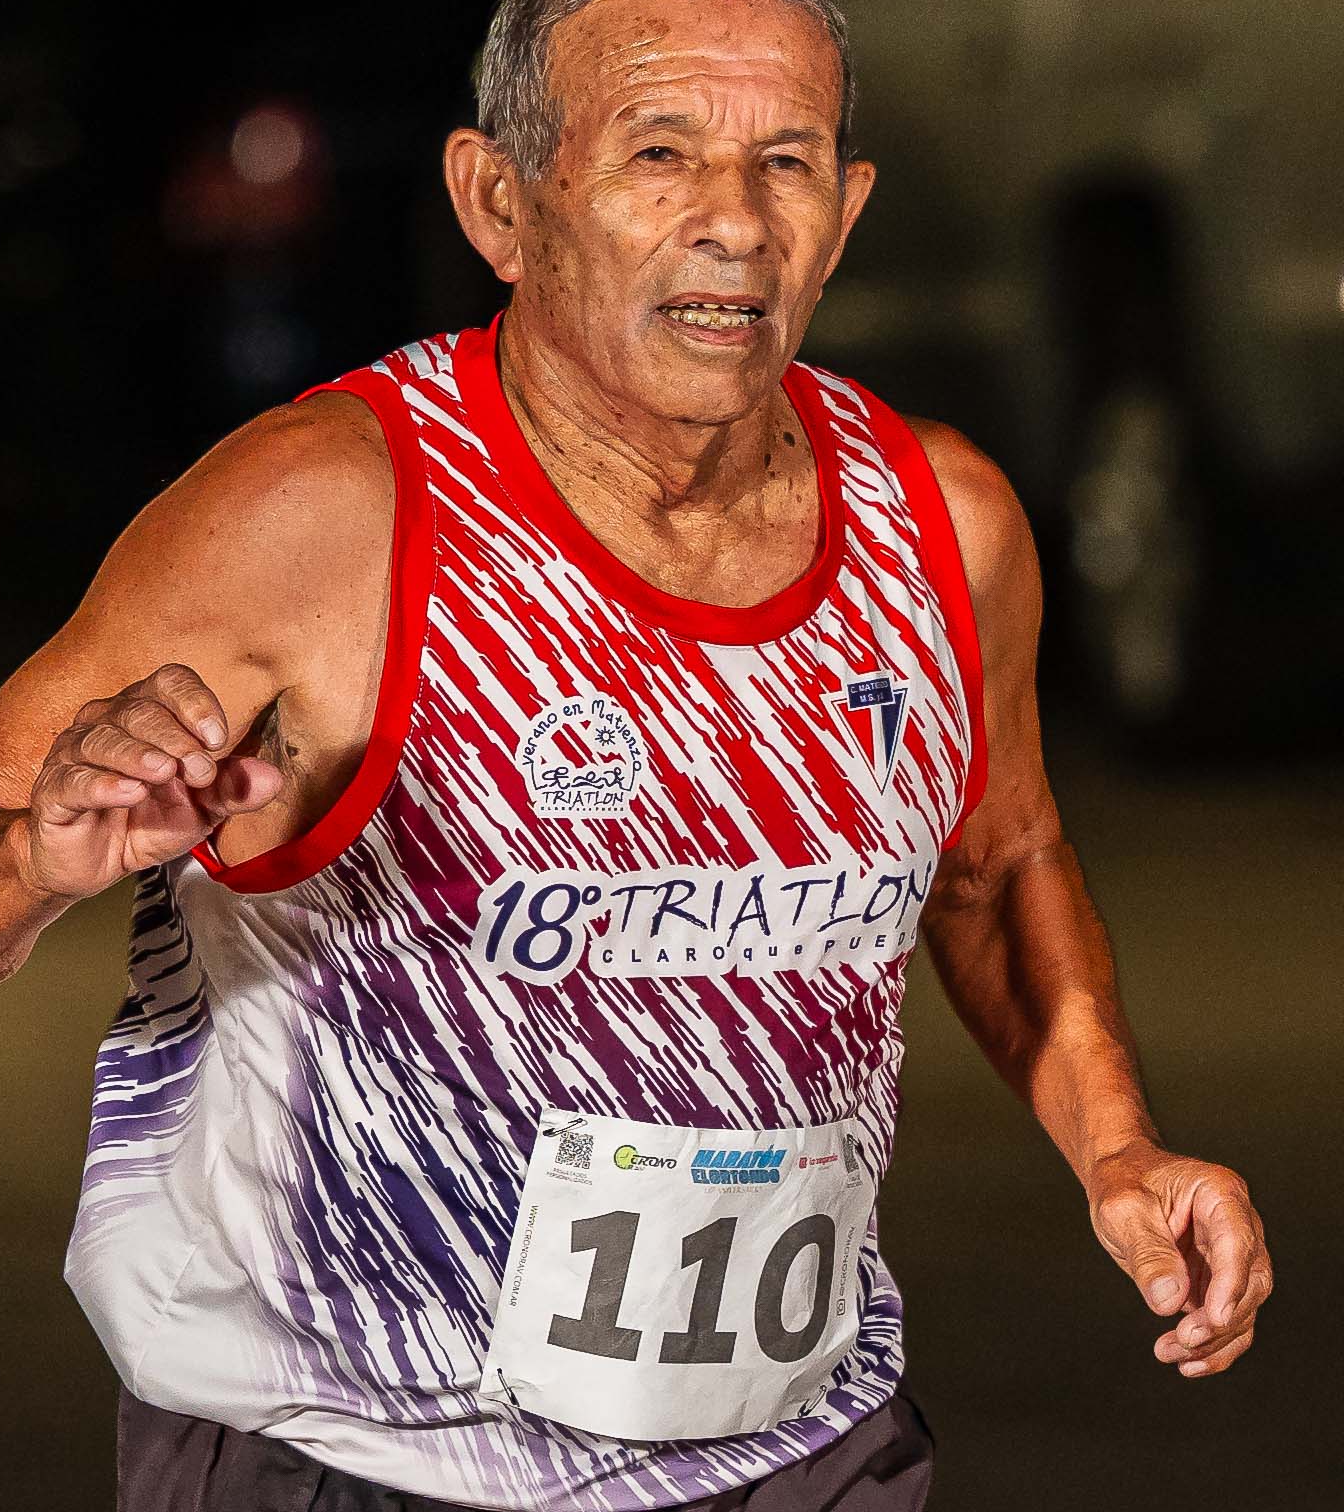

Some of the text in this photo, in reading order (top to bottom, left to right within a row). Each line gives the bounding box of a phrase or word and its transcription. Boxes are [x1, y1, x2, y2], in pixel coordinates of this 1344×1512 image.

[563, 704, 584, 717] en
[542, 790, 624, 808] TRIATLON
[610, 861, 931, 947] TRIATLON
[546, 1210, 836, 1364] 110
